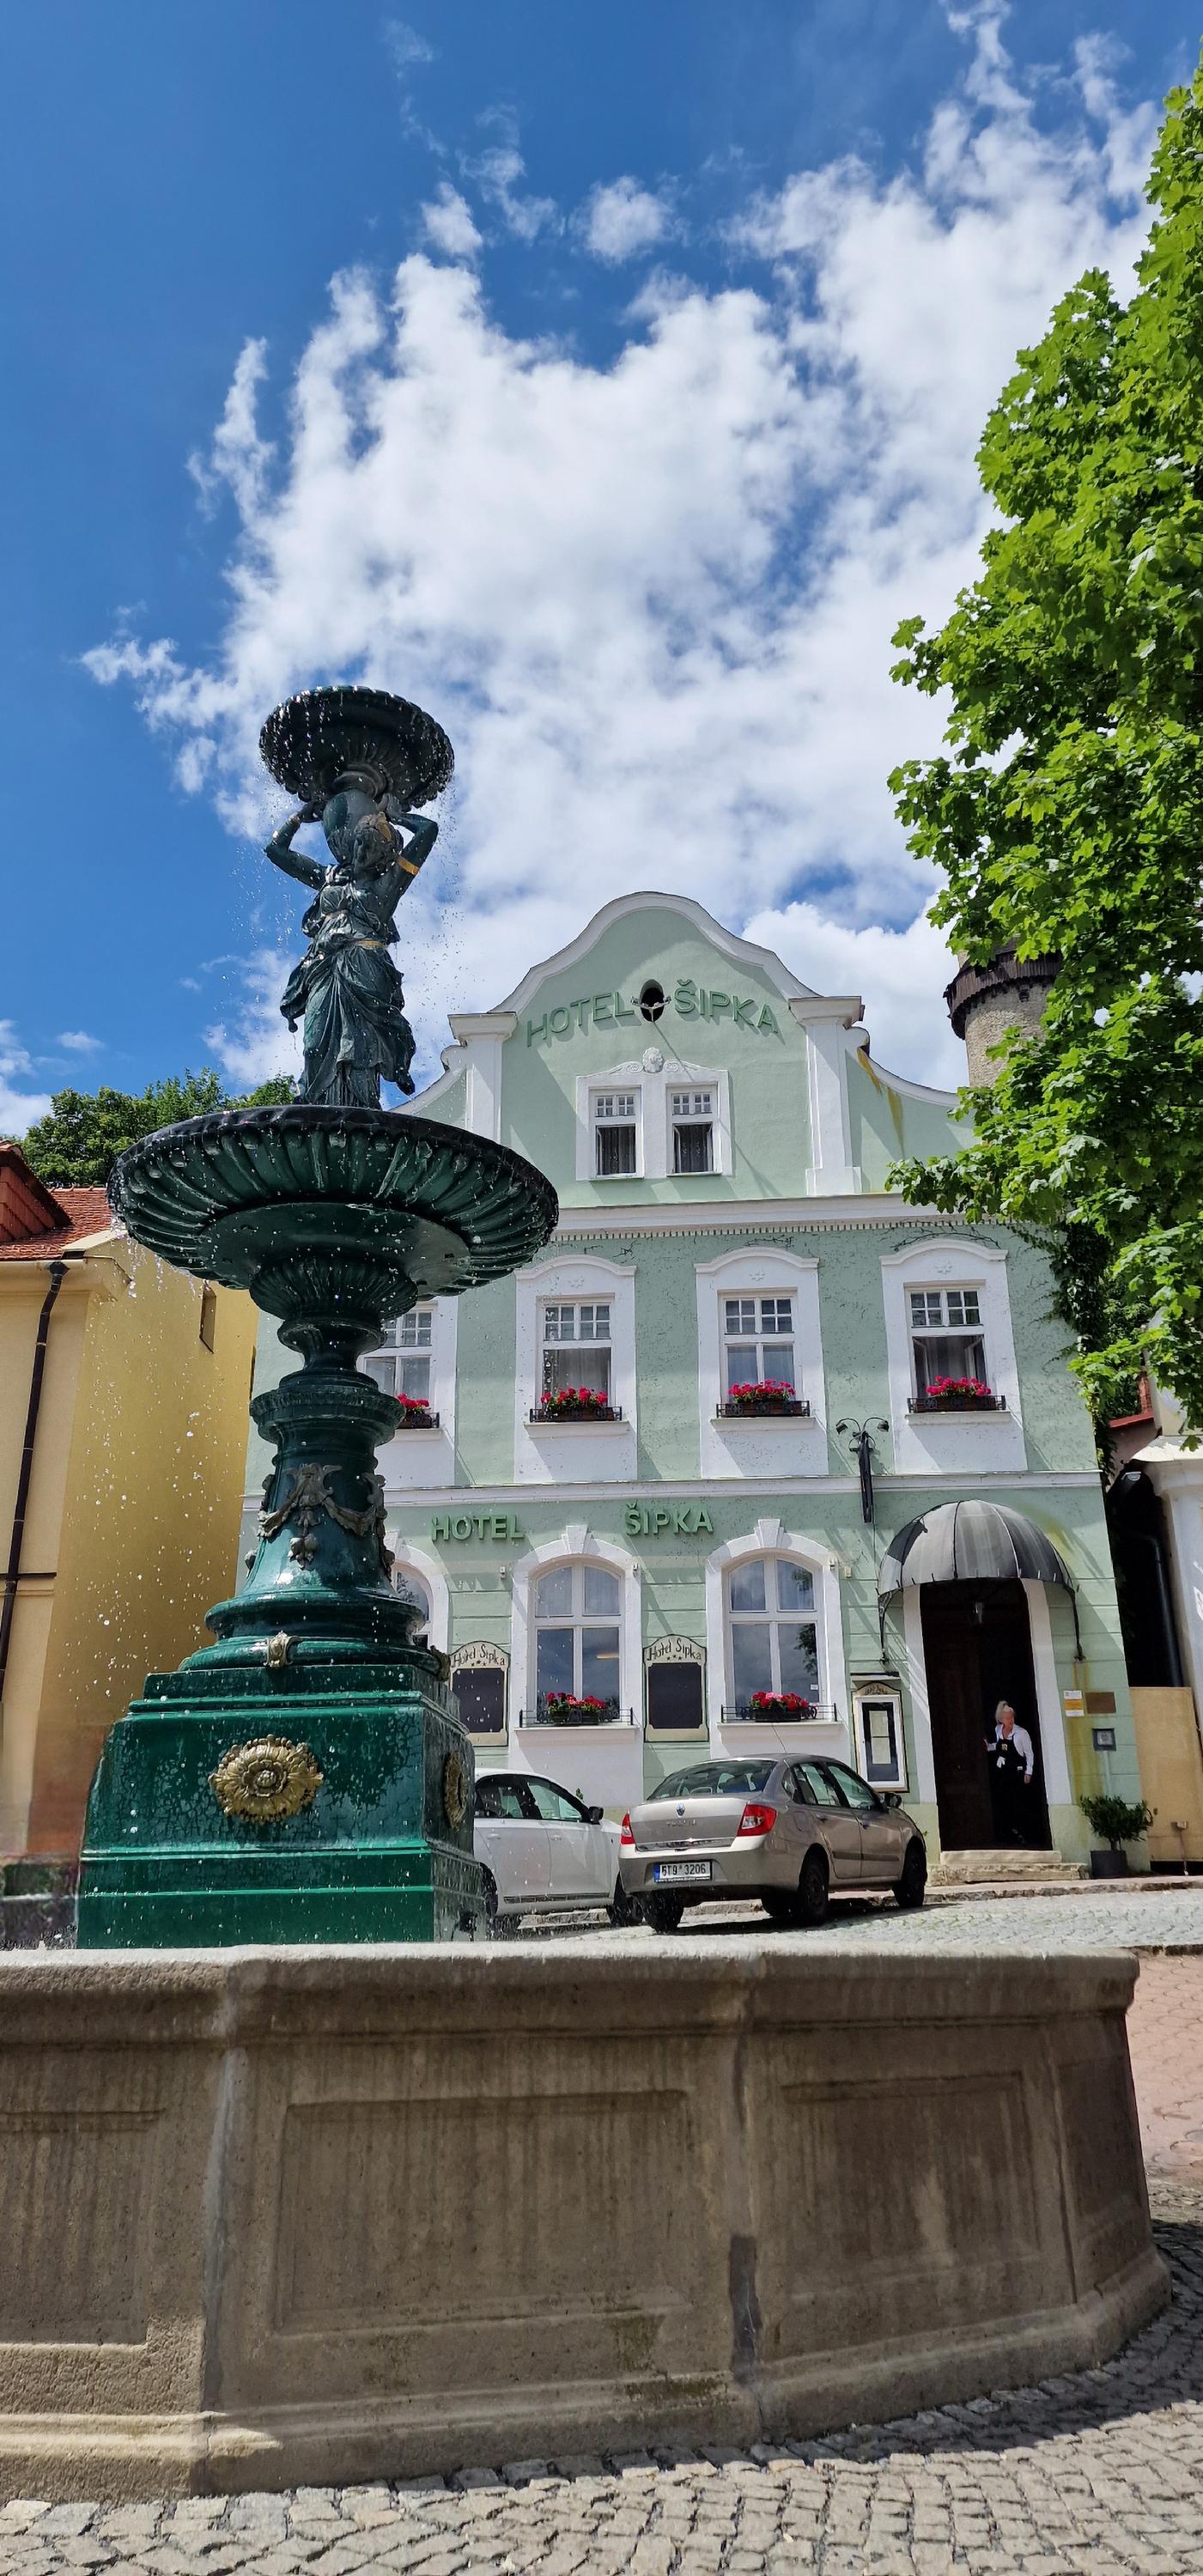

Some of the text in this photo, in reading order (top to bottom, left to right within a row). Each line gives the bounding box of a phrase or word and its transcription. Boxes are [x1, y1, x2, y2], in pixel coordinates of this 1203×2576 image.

[526, 979, 778, 1047] HOTEL ŠIPKA
[431, 1502, 714, 1541] HOTEL ŠIPKA
[684, 1863, 706, 1875] 3206
